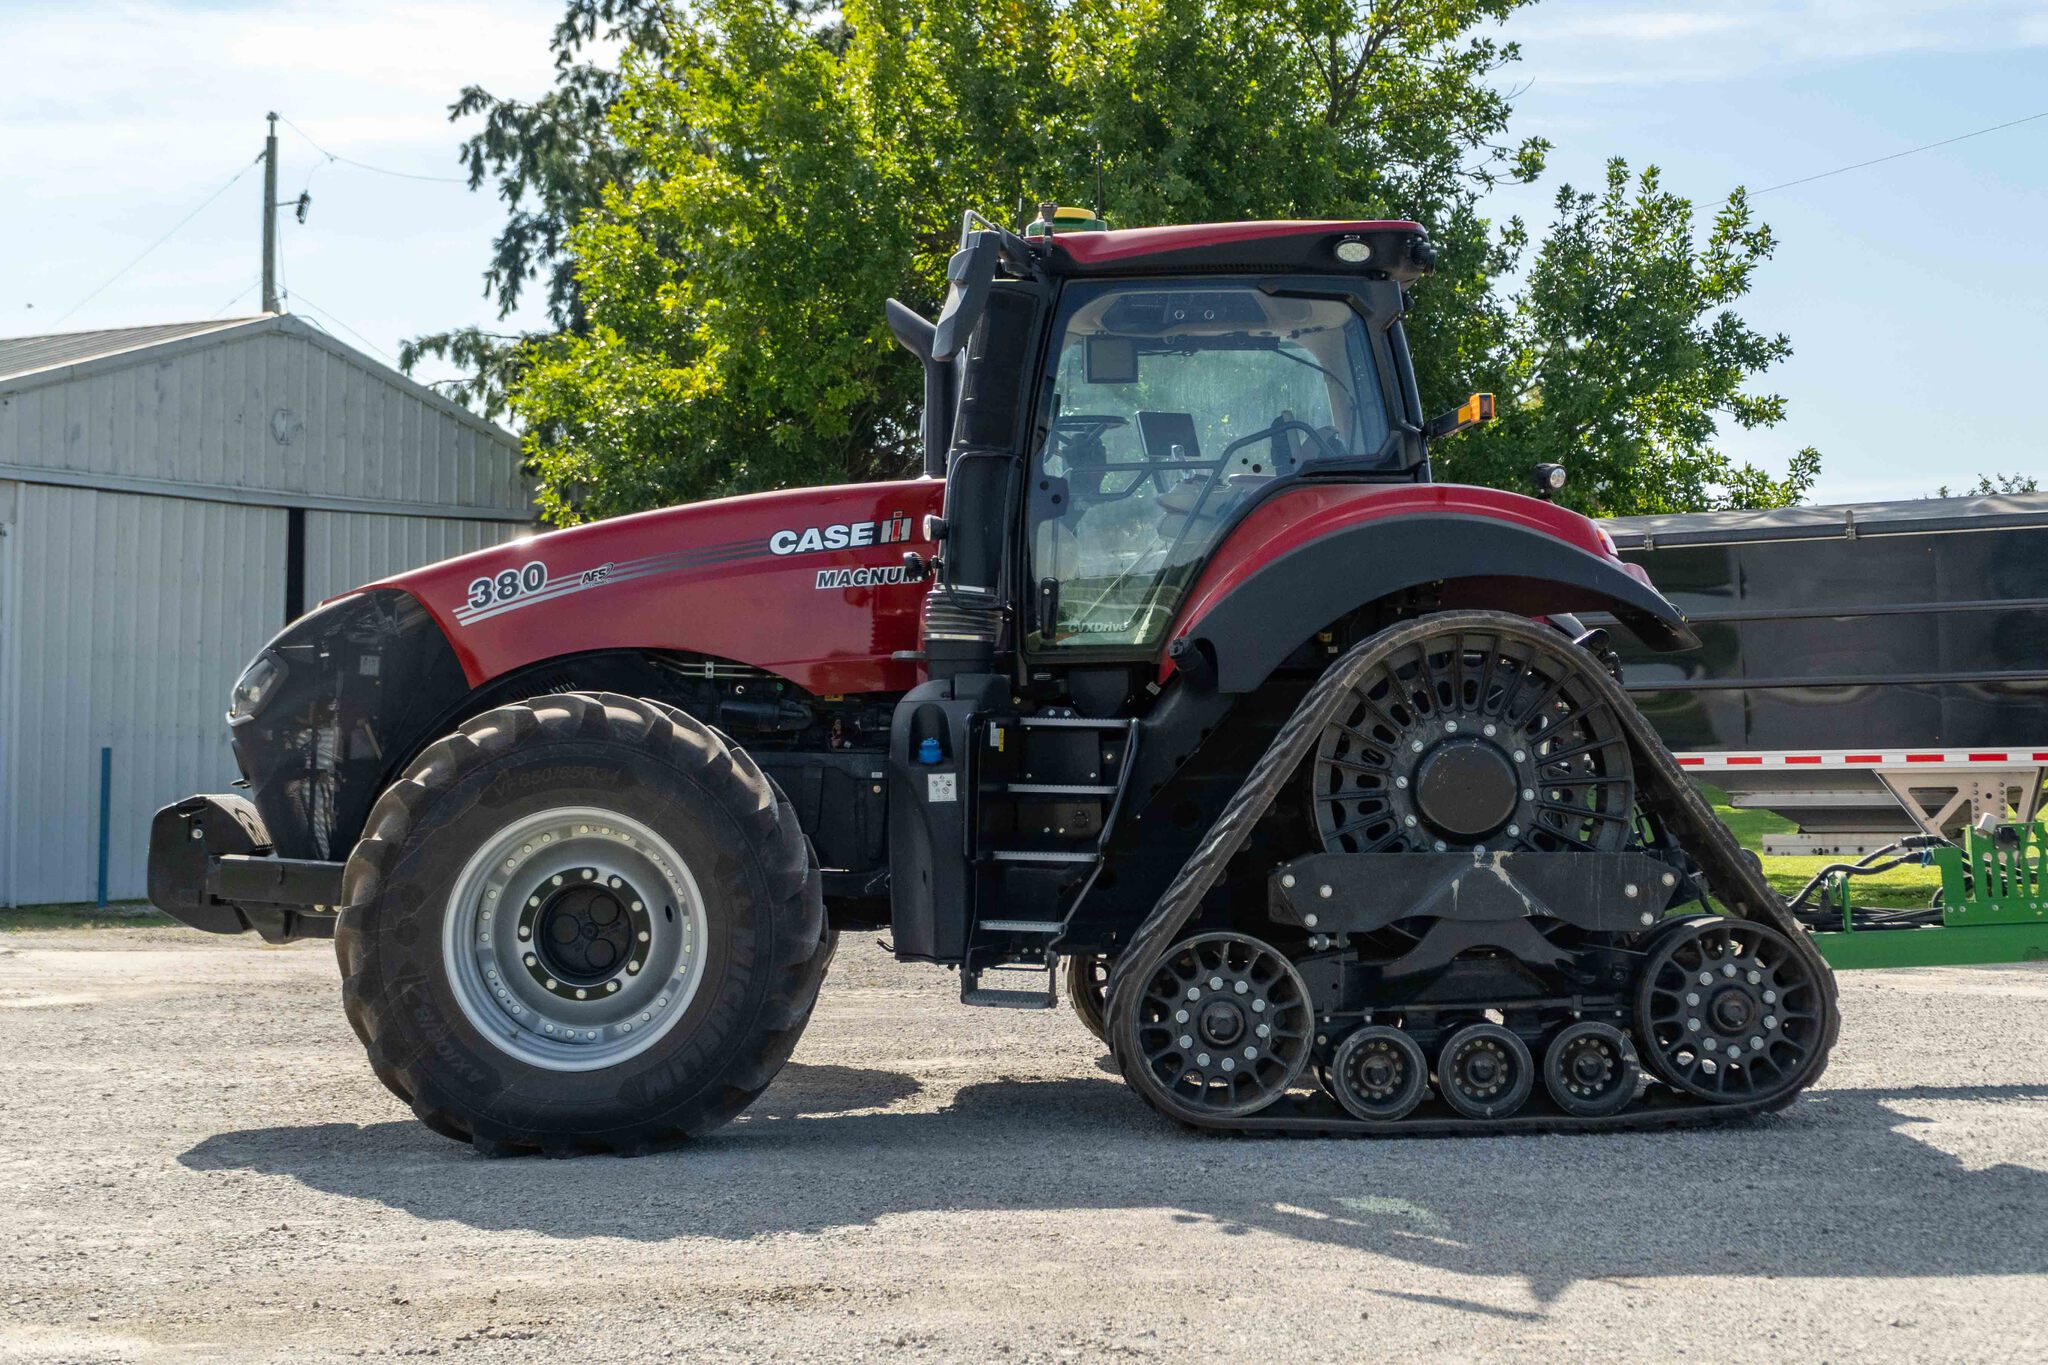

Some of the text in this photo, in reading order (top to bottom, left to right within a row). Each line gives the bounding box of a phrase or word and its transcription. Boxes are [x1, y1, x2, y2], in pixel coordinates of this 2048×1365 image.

[769, 521, 876, 556] CASE
[467, 561, 548, 611] 380
[581, 567, 608, 584] AFS
[1067, 621, 1128, 633] CVXDrive
[644, 926, 757, 1102] MICHELIN
